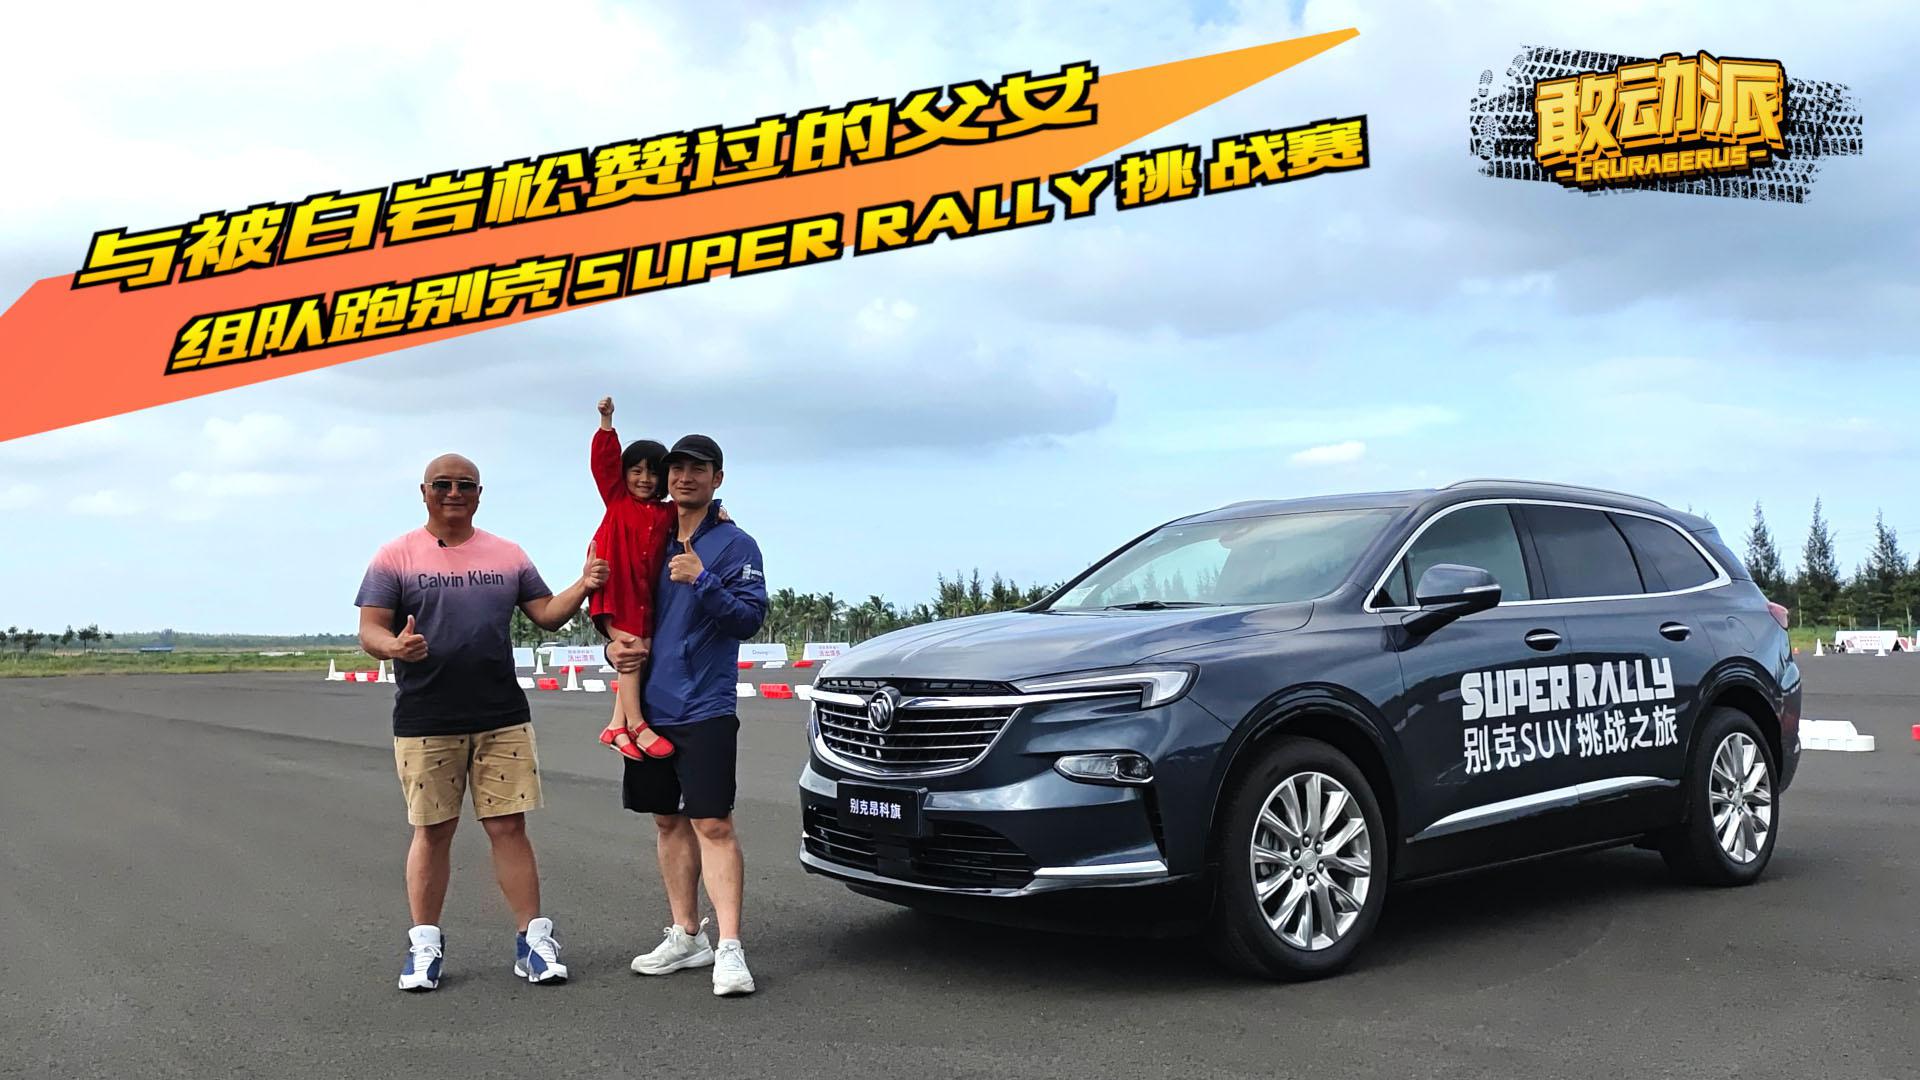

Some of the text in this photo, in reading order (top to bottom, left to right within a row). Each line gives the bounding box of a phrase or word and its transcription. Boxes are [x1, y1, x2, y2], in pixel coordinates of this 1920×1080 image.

[418, 569, 505, 590] Calvin Klein
[1460, 657, 1676, 721] SUPER RALLY
[849, 797, 902, 820] 别克昂科旗
